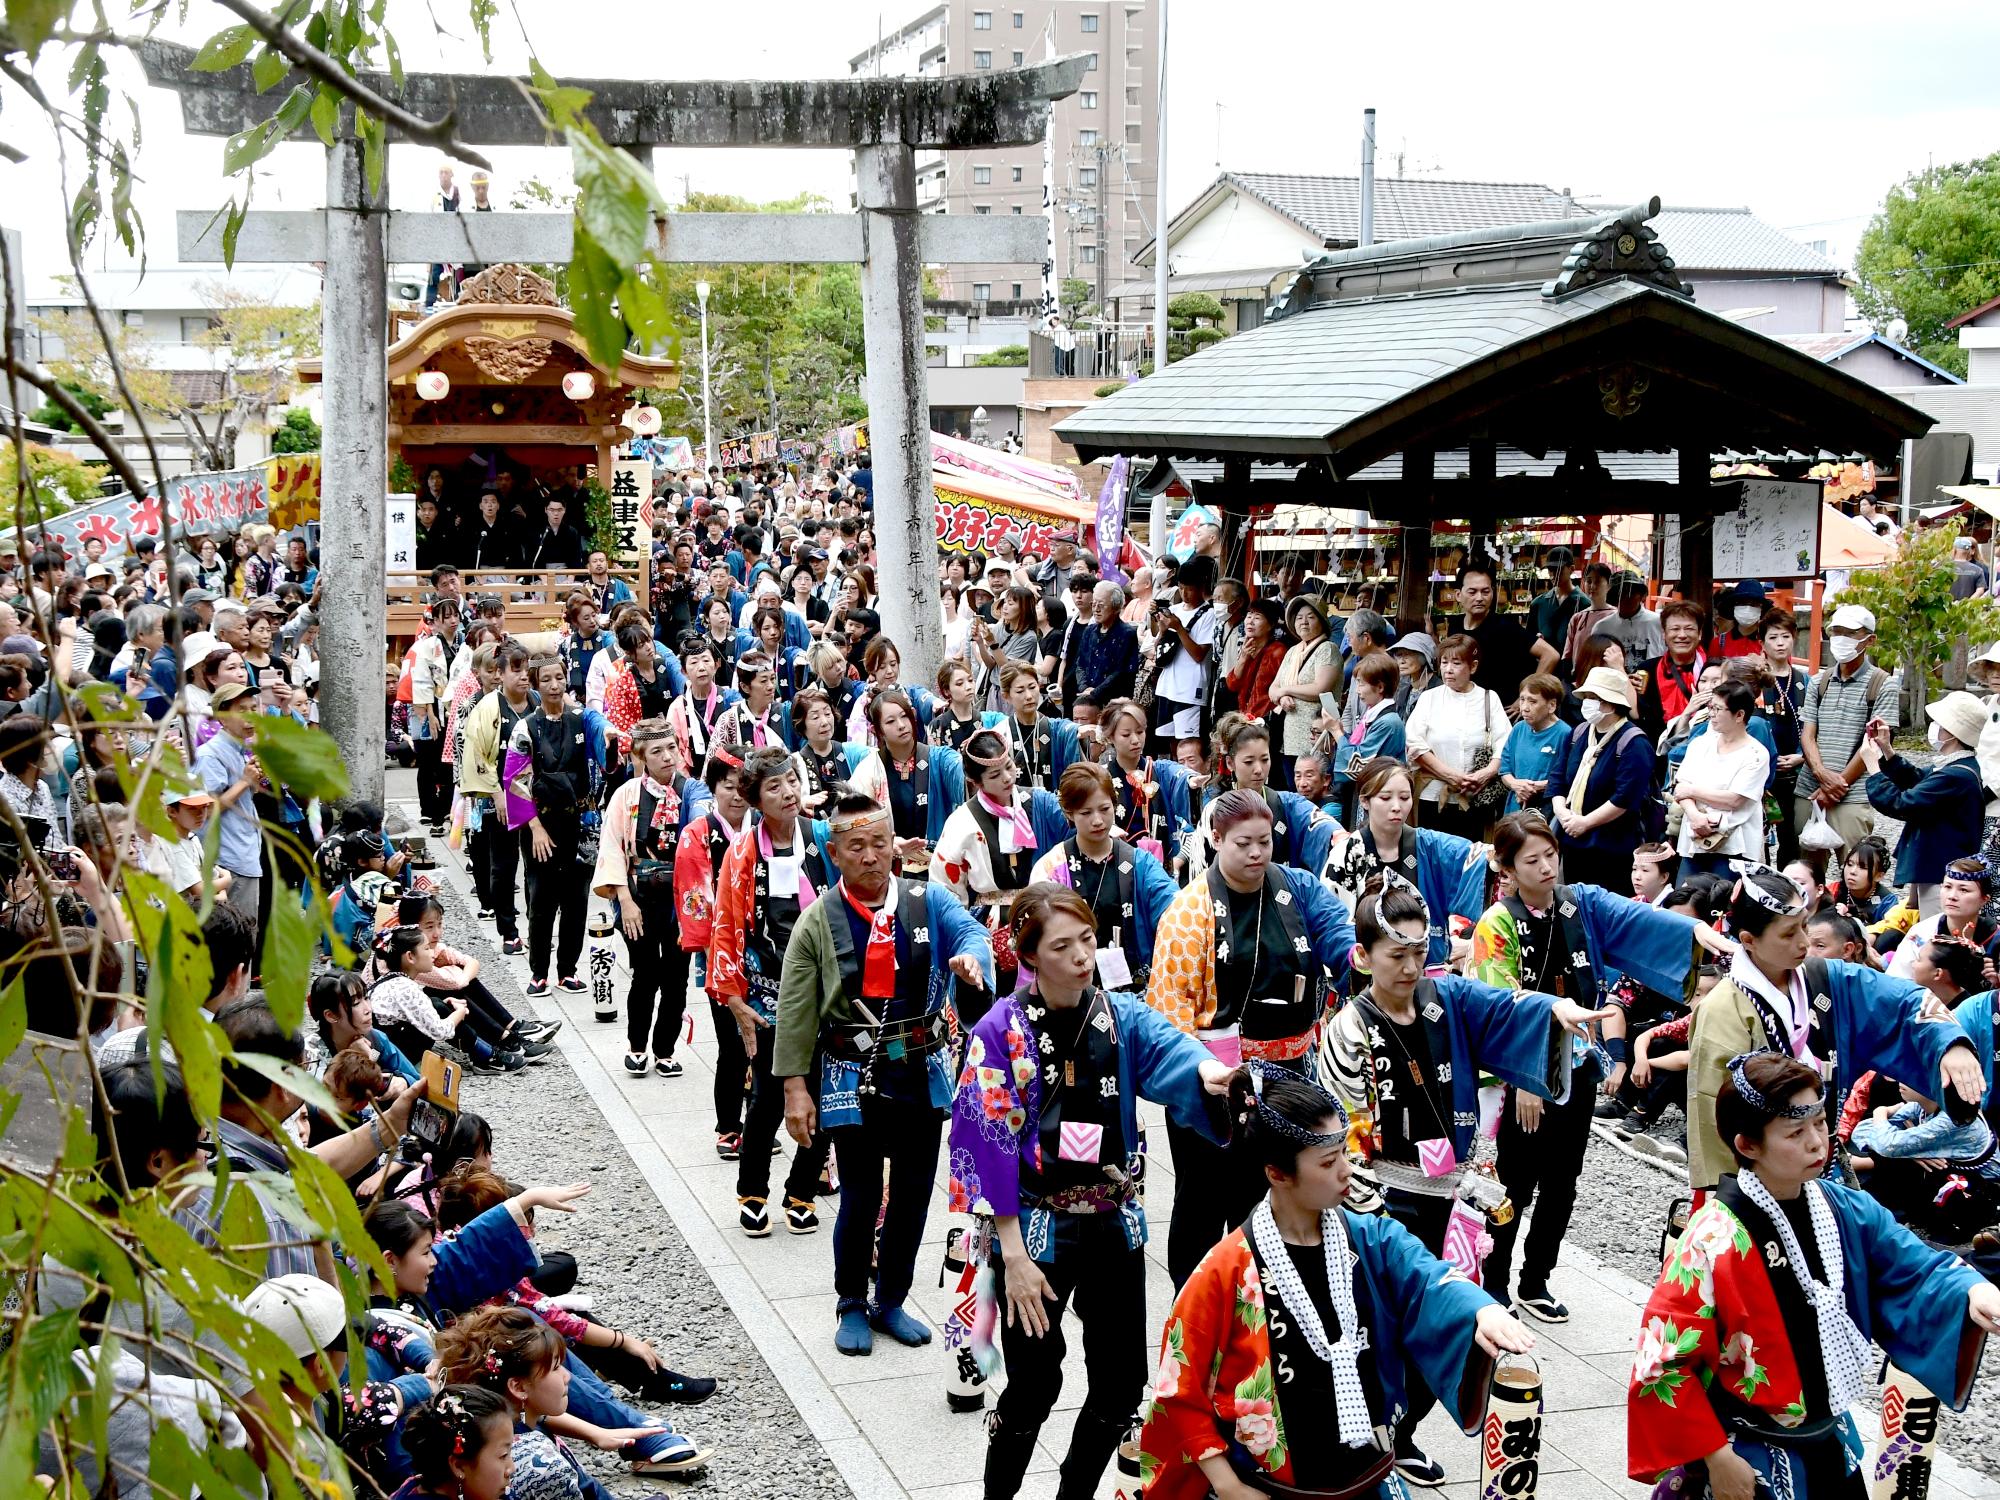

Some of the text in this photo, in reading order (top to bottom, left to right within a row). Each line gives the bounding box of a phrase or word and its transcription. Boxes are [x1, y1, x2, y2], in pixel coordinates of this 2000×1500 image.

[391, 511, 408, 563] 供奴
[612, 470, 640, 552] 益津区
[590, 948, 615, 1005] 秀樹
[1516, 919, 1537, 983] れいみ
[1025, 1004, 1059, 1085] 加奈子
[1367, 1024, 1396, 1101] 美の里
[1260, 1267, 1294, 1384] きらら
